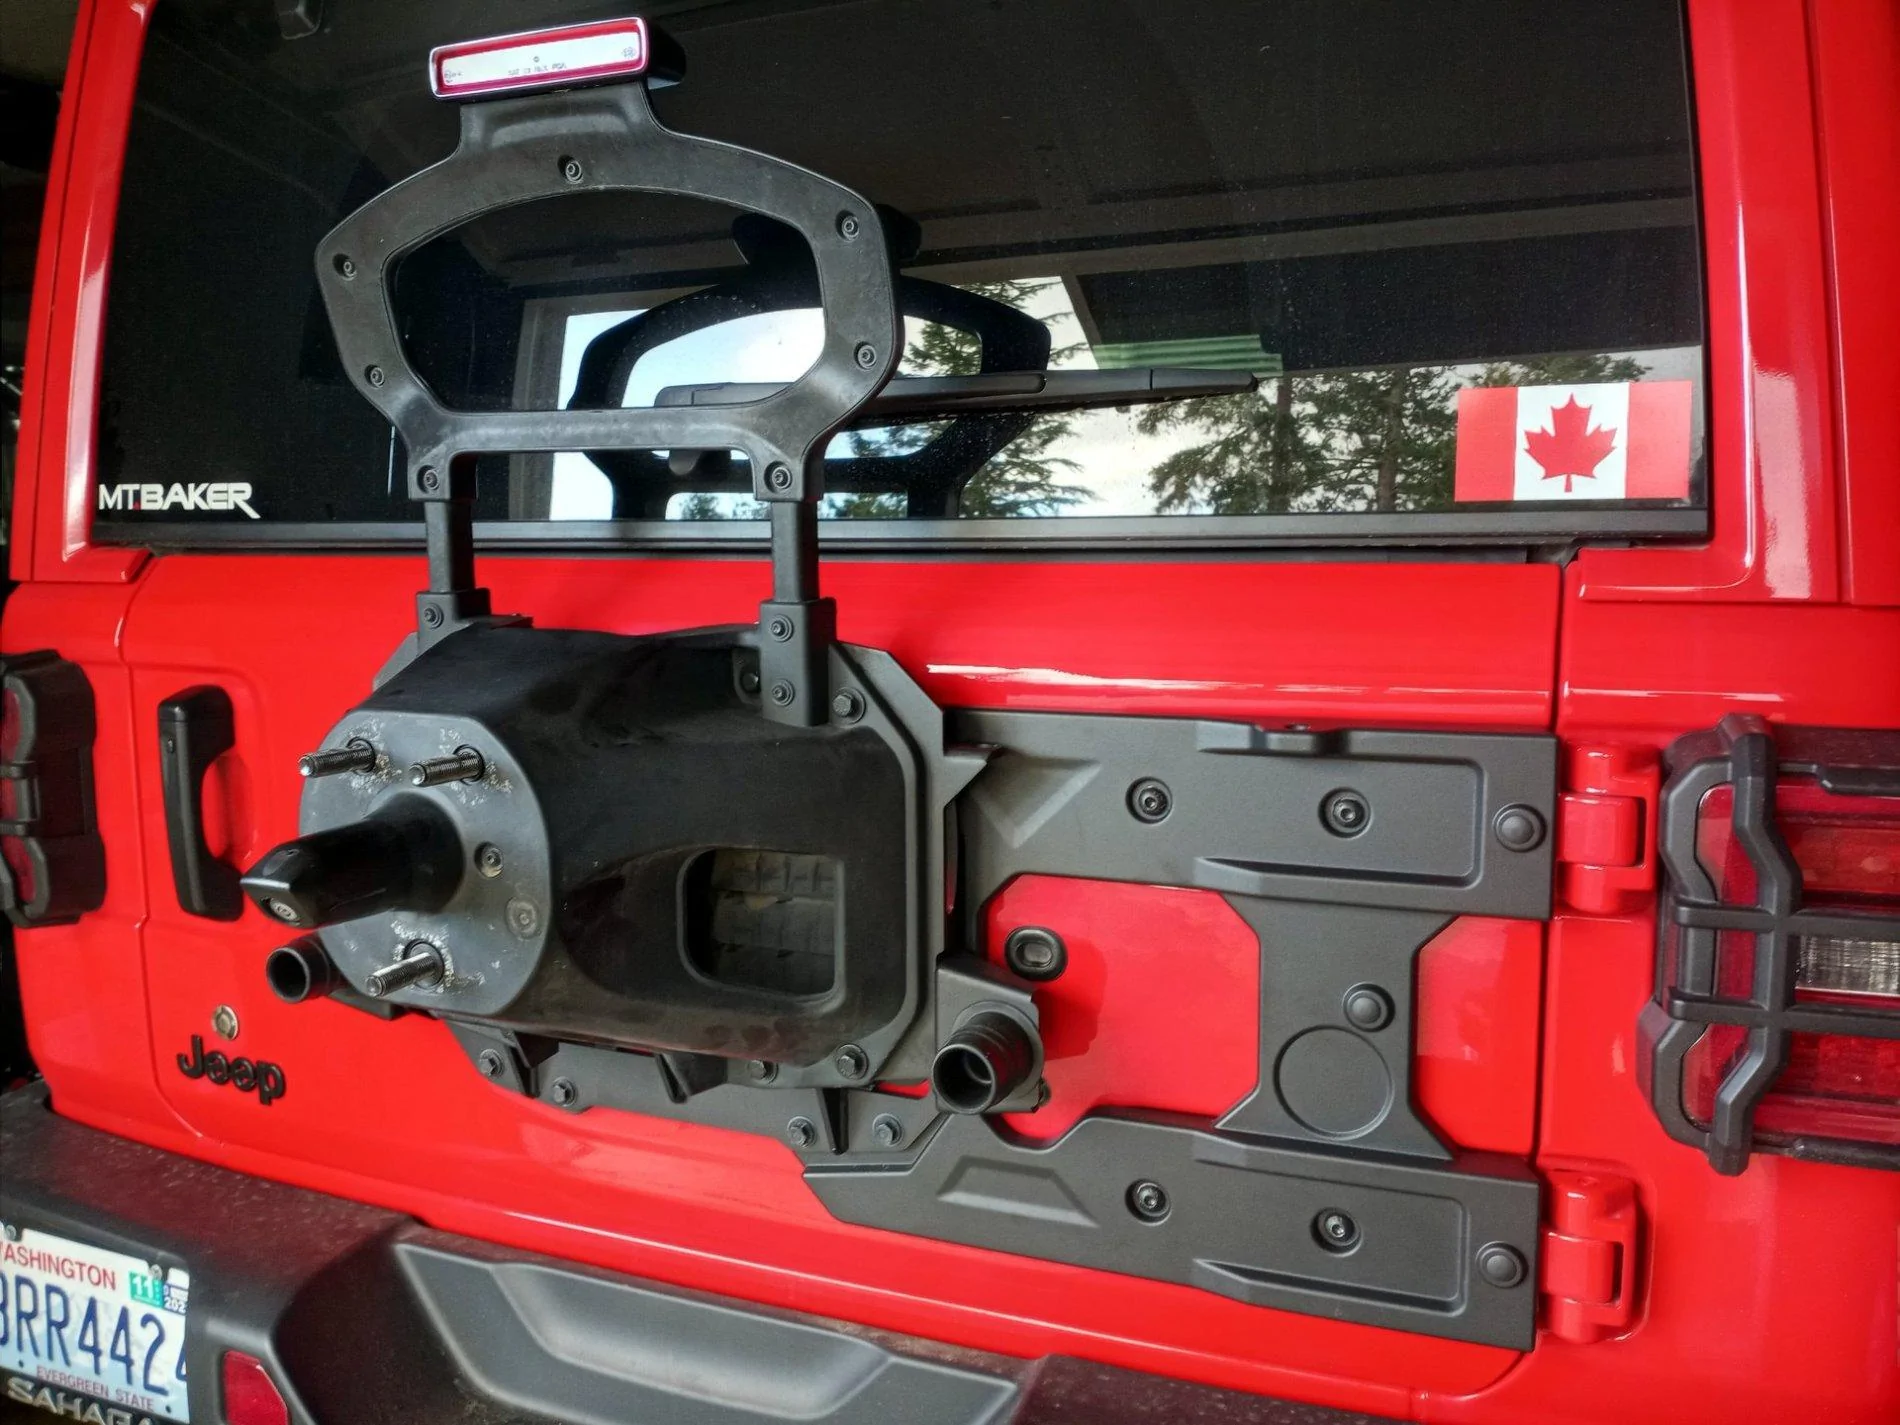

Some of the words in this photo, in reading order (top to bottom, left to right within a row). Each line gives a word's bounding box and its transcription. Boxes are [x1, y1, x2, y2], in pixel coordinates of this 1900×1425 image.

[176, 1034, 287, 1106] Jeep
[0, 1241, 116, 1291] ASHINGTON
[132, 1275, 153, 1299] 11
[36, 1365, 110, 1398] EVERGREEN
[115, 1388, 155, 1412] STATE
